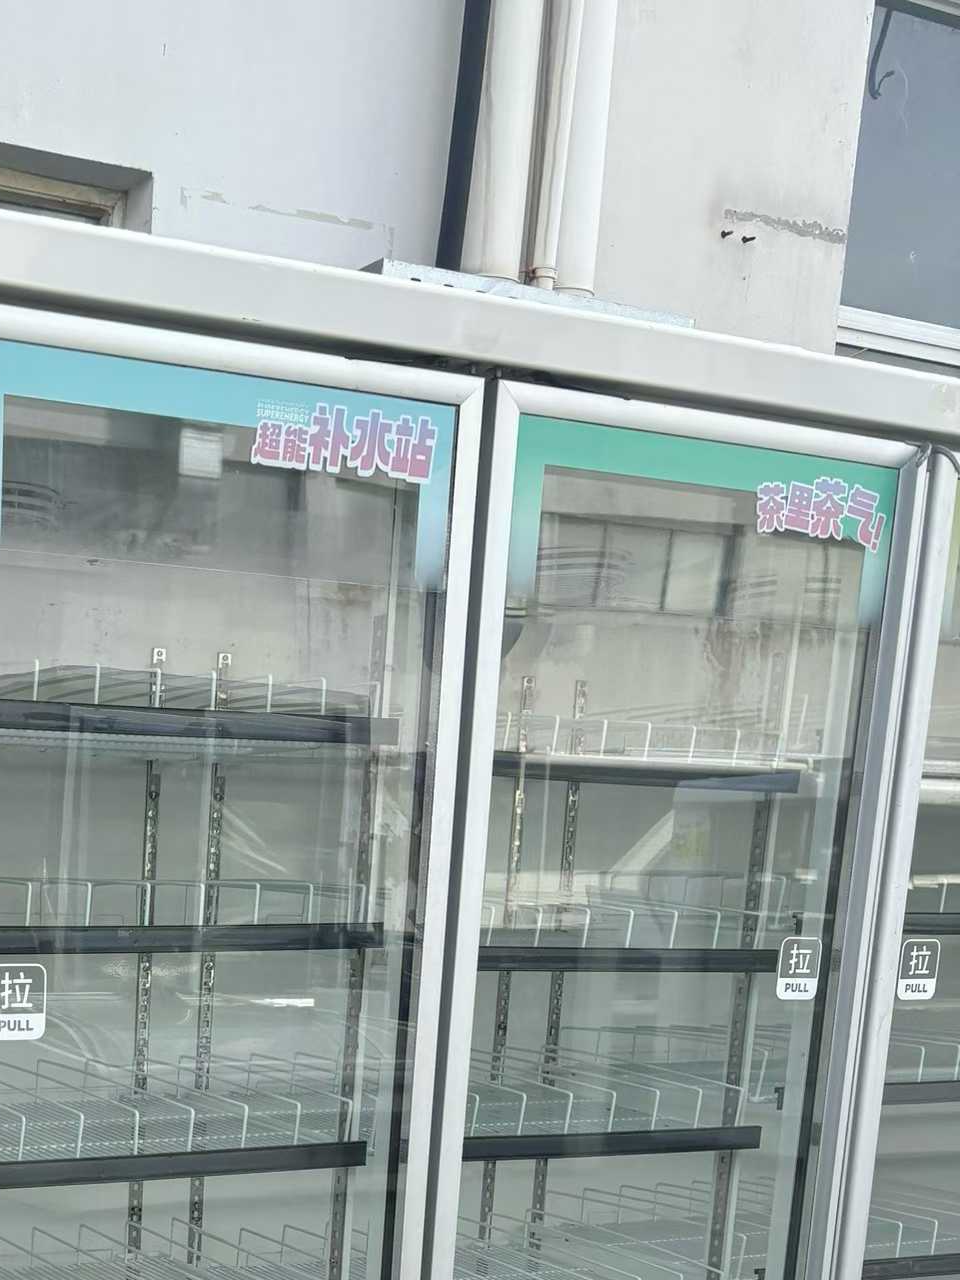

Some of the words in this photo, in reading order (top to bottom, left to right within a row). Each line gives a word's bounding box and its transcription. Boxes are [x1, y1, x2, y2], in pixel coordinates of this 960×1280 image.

[251, 402, 438, 484] 超能补水站
[789, 943, 813, 974] 拉
[909, 945, 931, 975] 拉
[0, 971, 33, 1010] 拉
[784, 982, 809, 993] PULL
[904, 983, 928, 993] PULL
